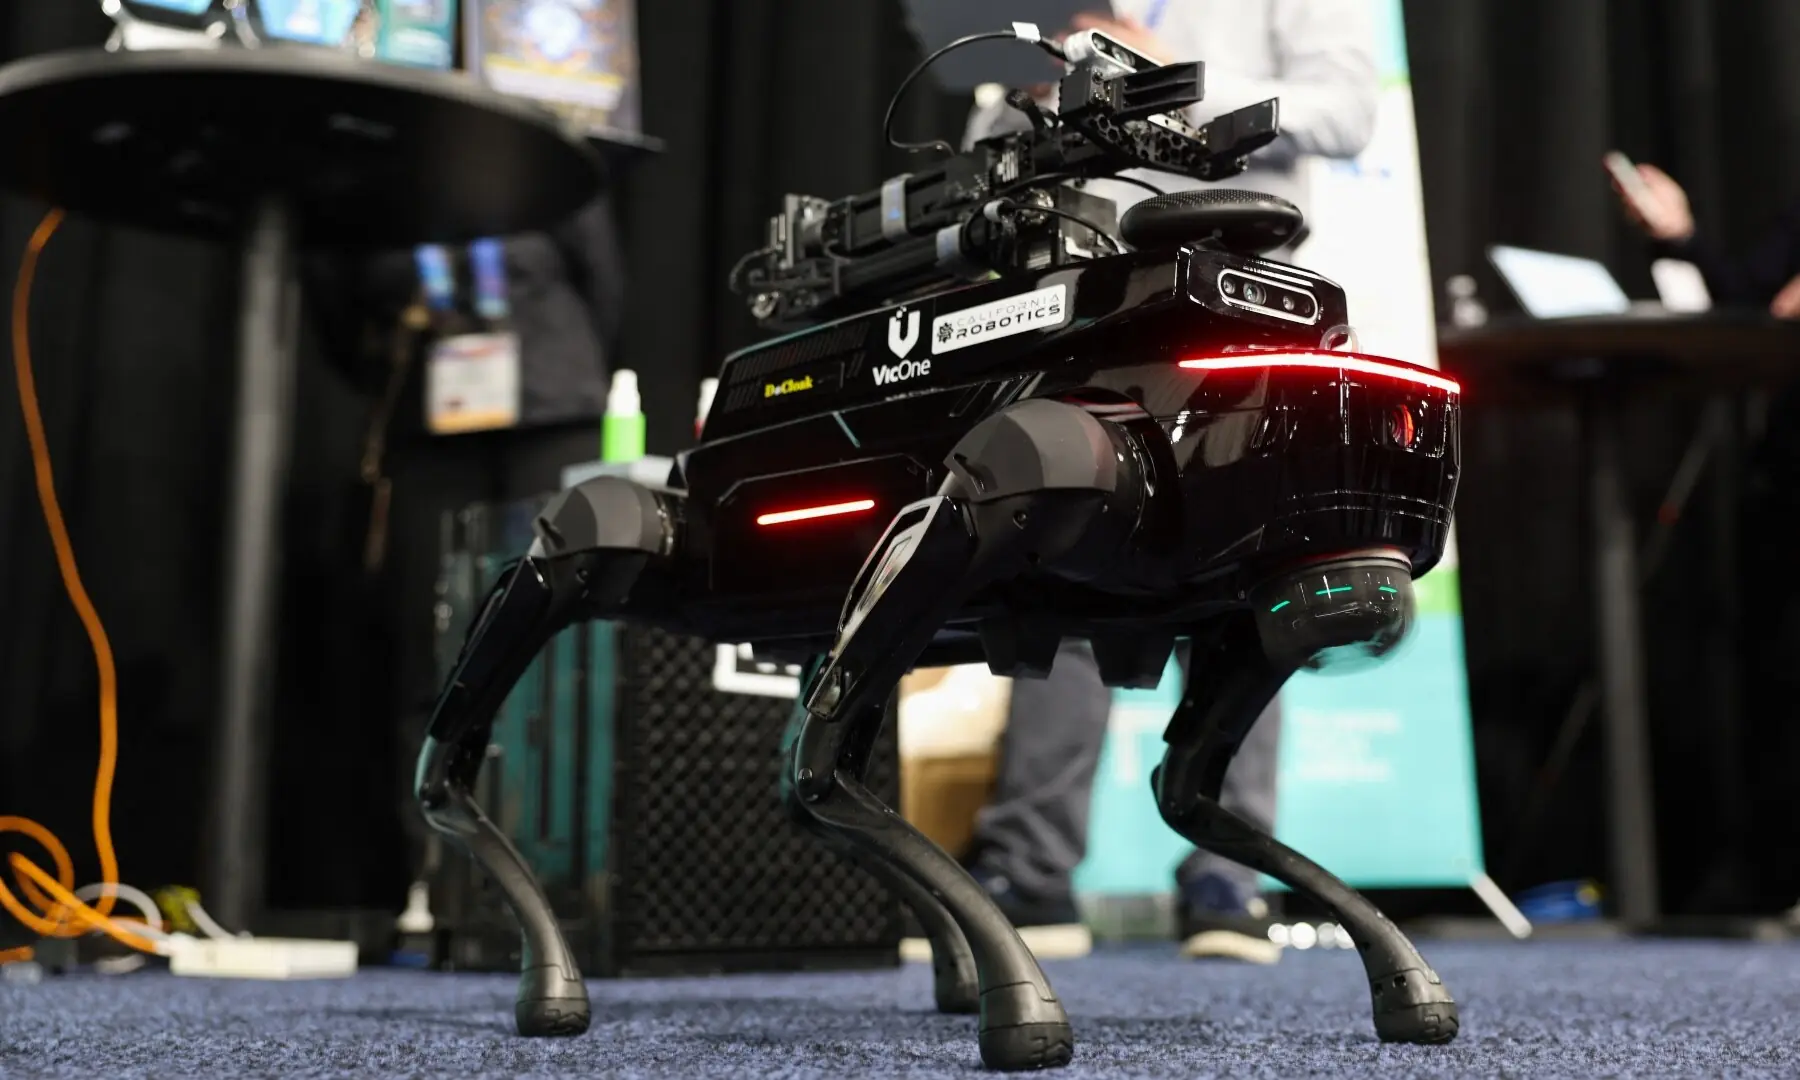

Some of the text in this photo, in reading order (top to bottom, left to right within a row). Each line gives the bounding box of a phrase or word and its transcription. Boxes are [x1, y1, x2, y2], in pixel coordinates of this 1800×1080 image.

[957, 294, 1060, 326] CALIFORNIA
[957, 305, 1060, 339] ROBOTICS
[872, 359, 931, 386] VicOne
